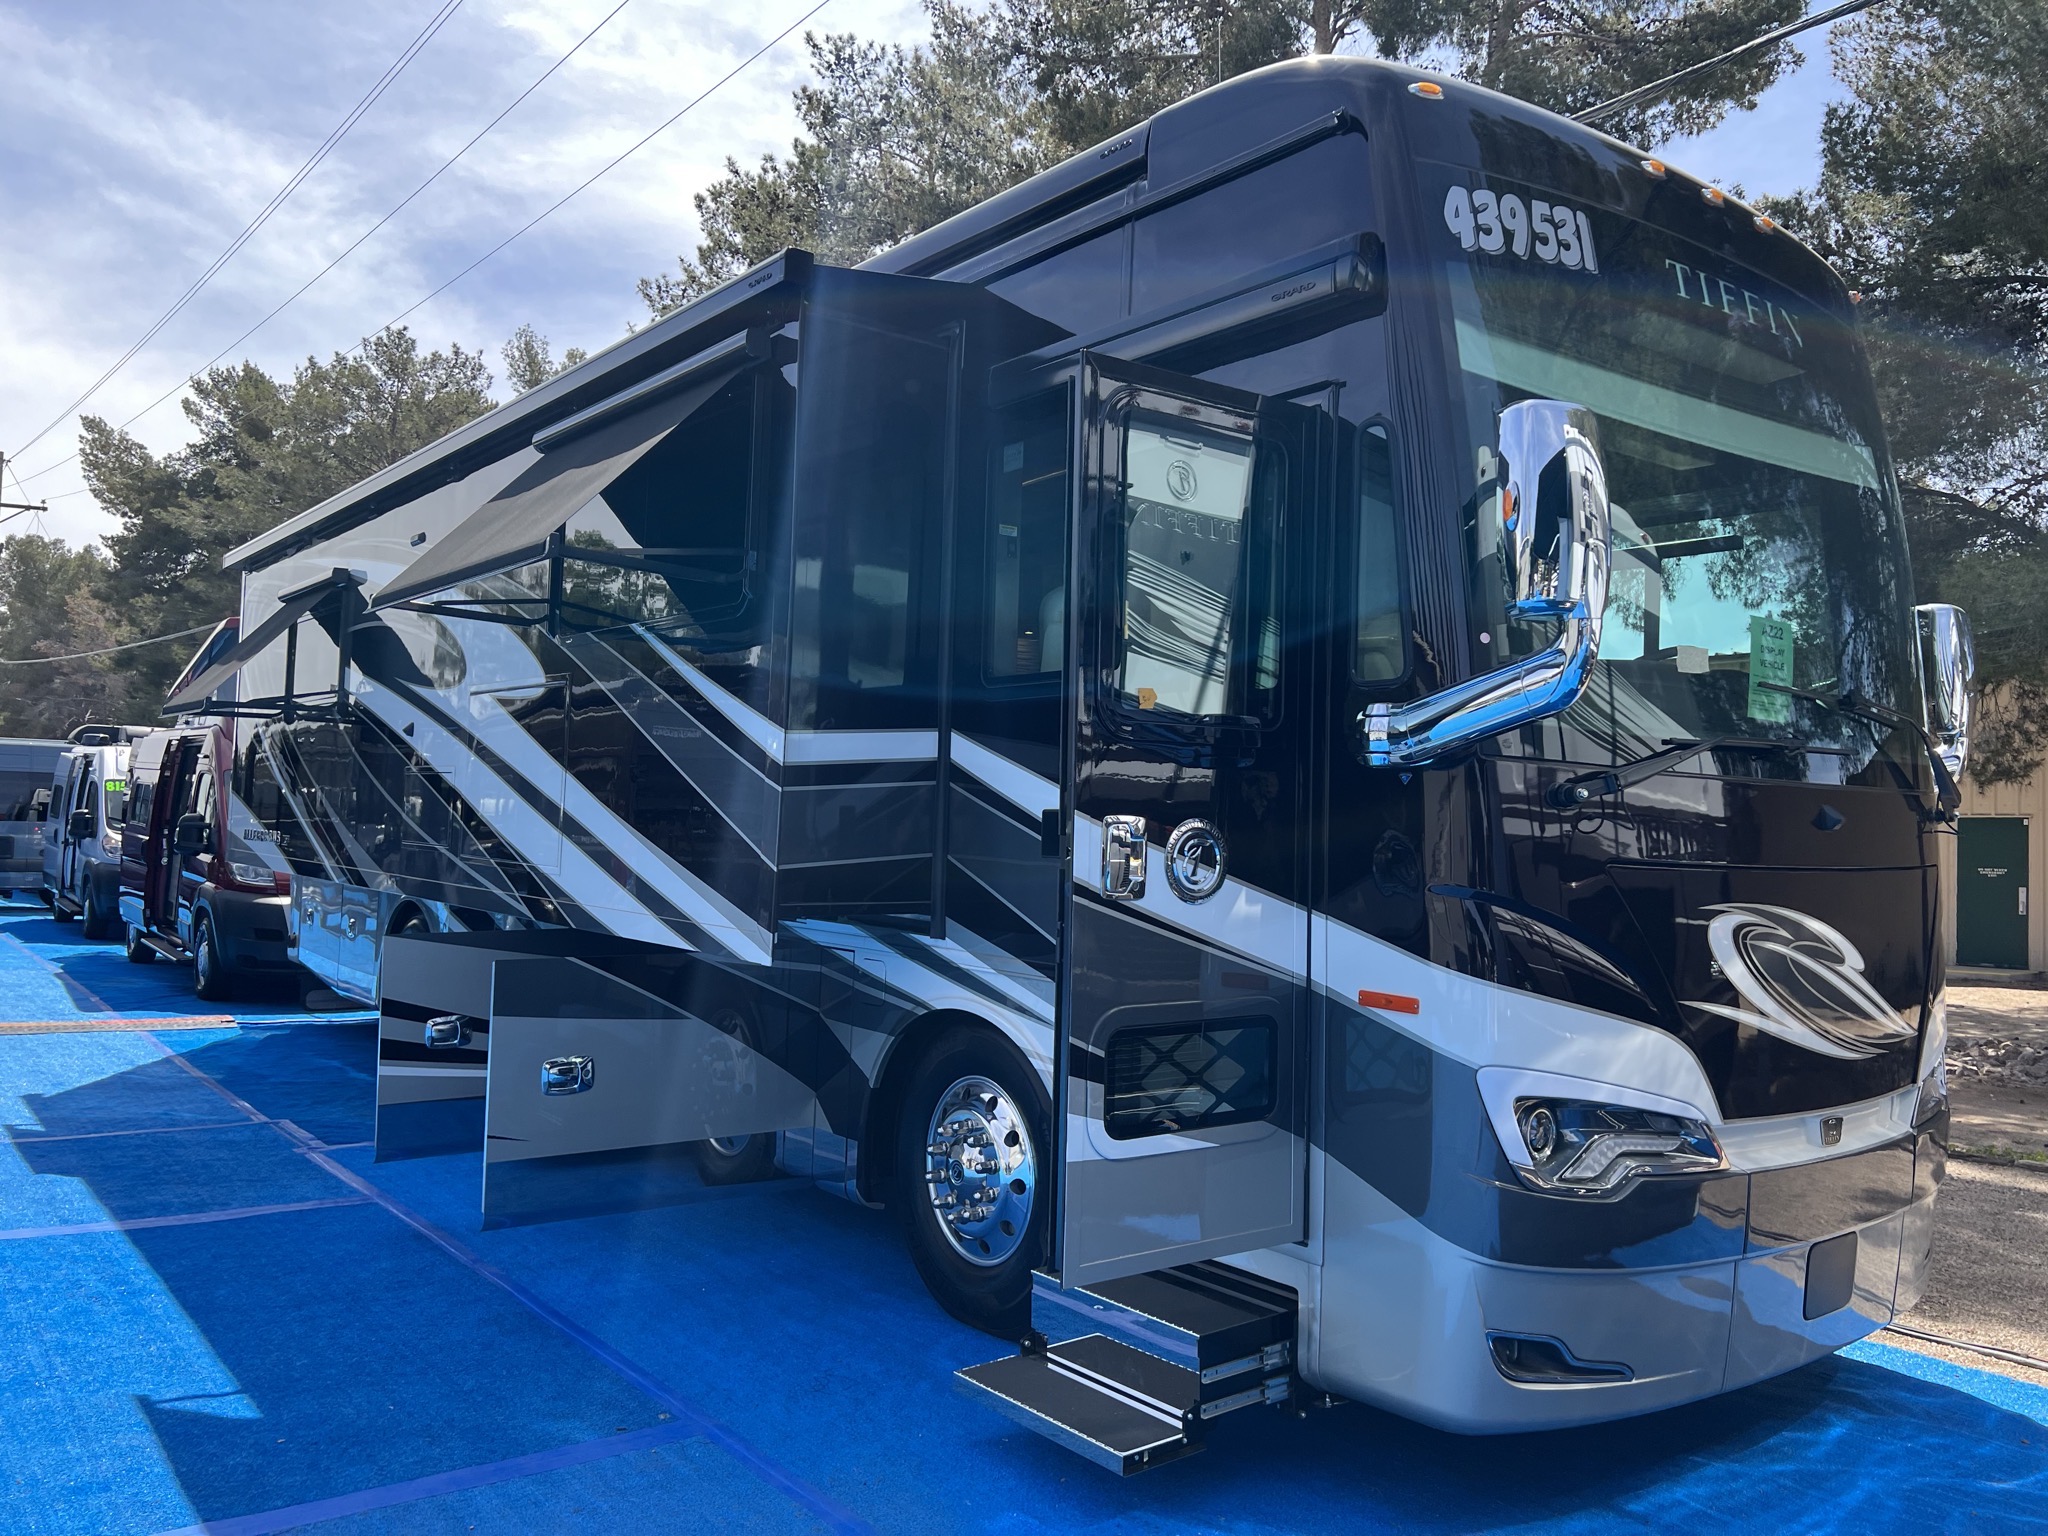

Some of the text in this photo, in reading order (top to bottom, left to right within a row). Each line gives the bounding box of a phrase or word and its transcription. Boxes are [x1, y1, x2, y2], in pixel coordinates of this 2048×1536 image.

[1443, 185, 1599, 274] 439531
[1271, 282, 1317, 302] GIRARD
[1665, 258, 1803, 348] TIFFIN
